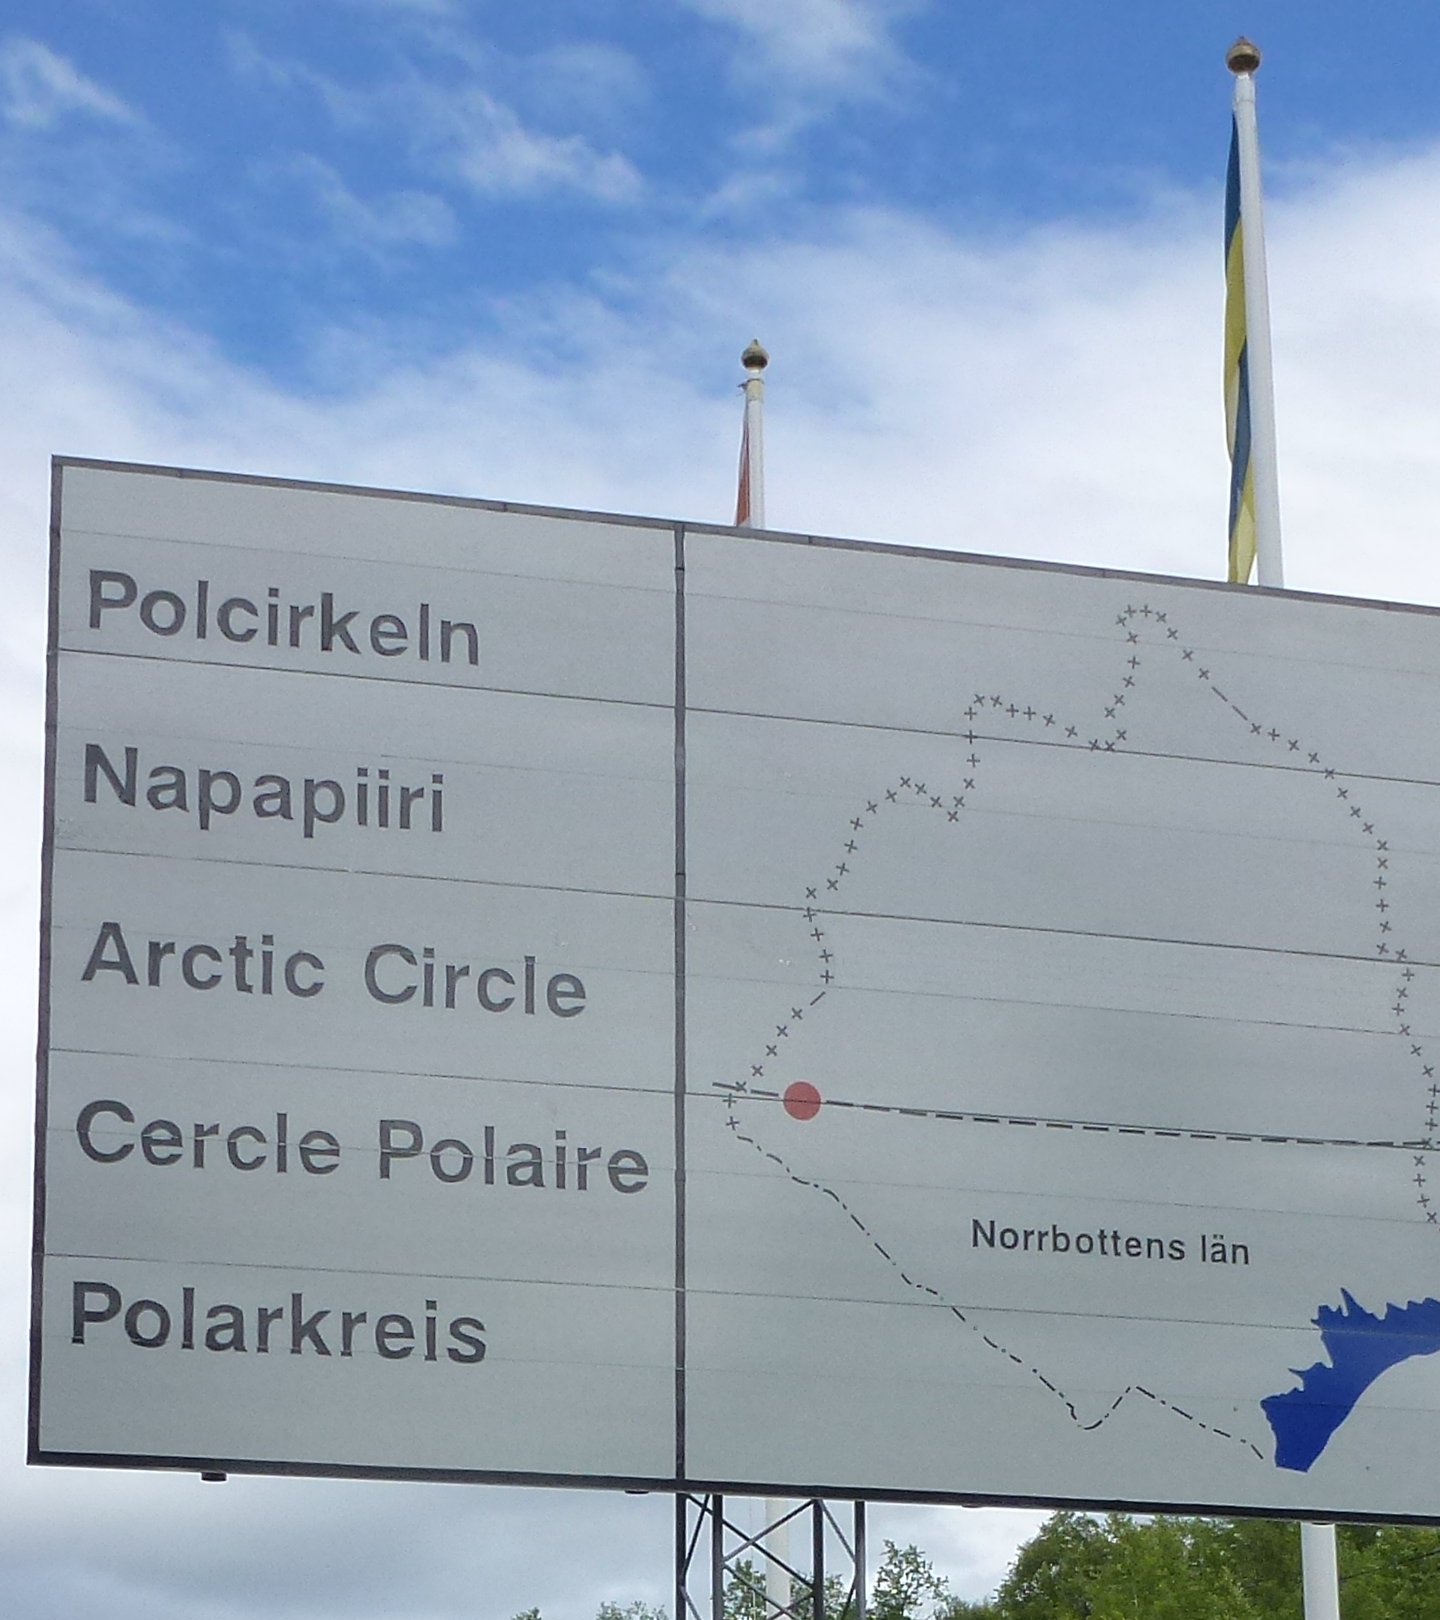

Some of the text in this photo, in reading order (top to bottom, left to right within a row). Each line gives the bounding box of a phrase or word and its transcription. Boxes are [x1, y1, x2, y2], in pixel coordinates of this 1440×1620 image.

[89, 569, 479, 666] Polcirkeln
[84, 743, 444, 839] Napapiiri
[81, 921, 588, 1018] Arctic Circle
[75, 1099, 650, 1194] Cercle Polaire
[972, 1218, 1250, 1265] Norrbottens län
[71, 1280, 488, 1364] Polarkreis
